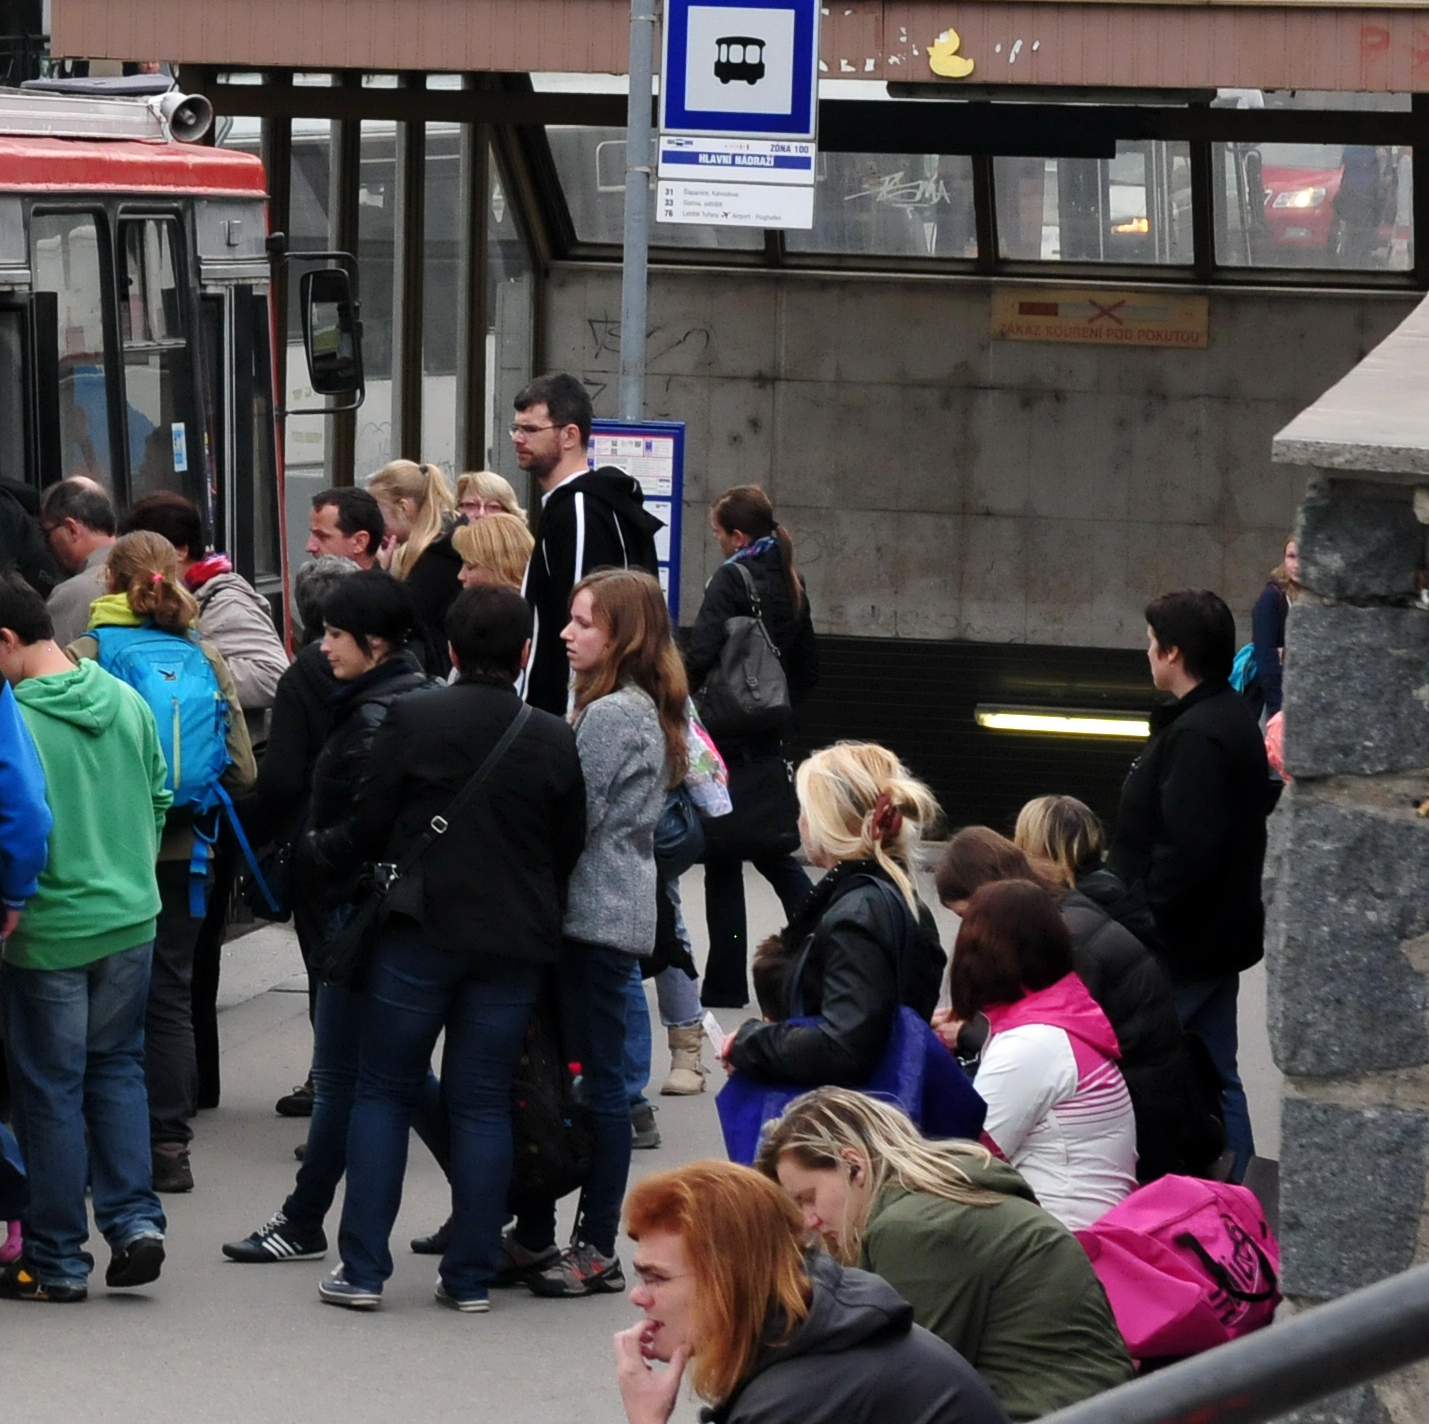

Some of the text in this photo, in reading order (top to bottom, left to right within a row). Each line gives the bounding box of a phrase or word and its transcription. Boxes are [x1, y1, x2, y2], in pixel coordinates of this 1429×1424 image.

[770, 143, 809, 153] ZÓNA 100
[698, 153, 775, 167] HLAVNÍ NÁDRAŽÍ
[664, 188, 674, 196] 31
[664, 199, 674, 207] 33
[664, 209, 674, 218] 76
[1106, 328, 1133, 340] POD
[1137, 329, 1200, 343] POKUTOU
